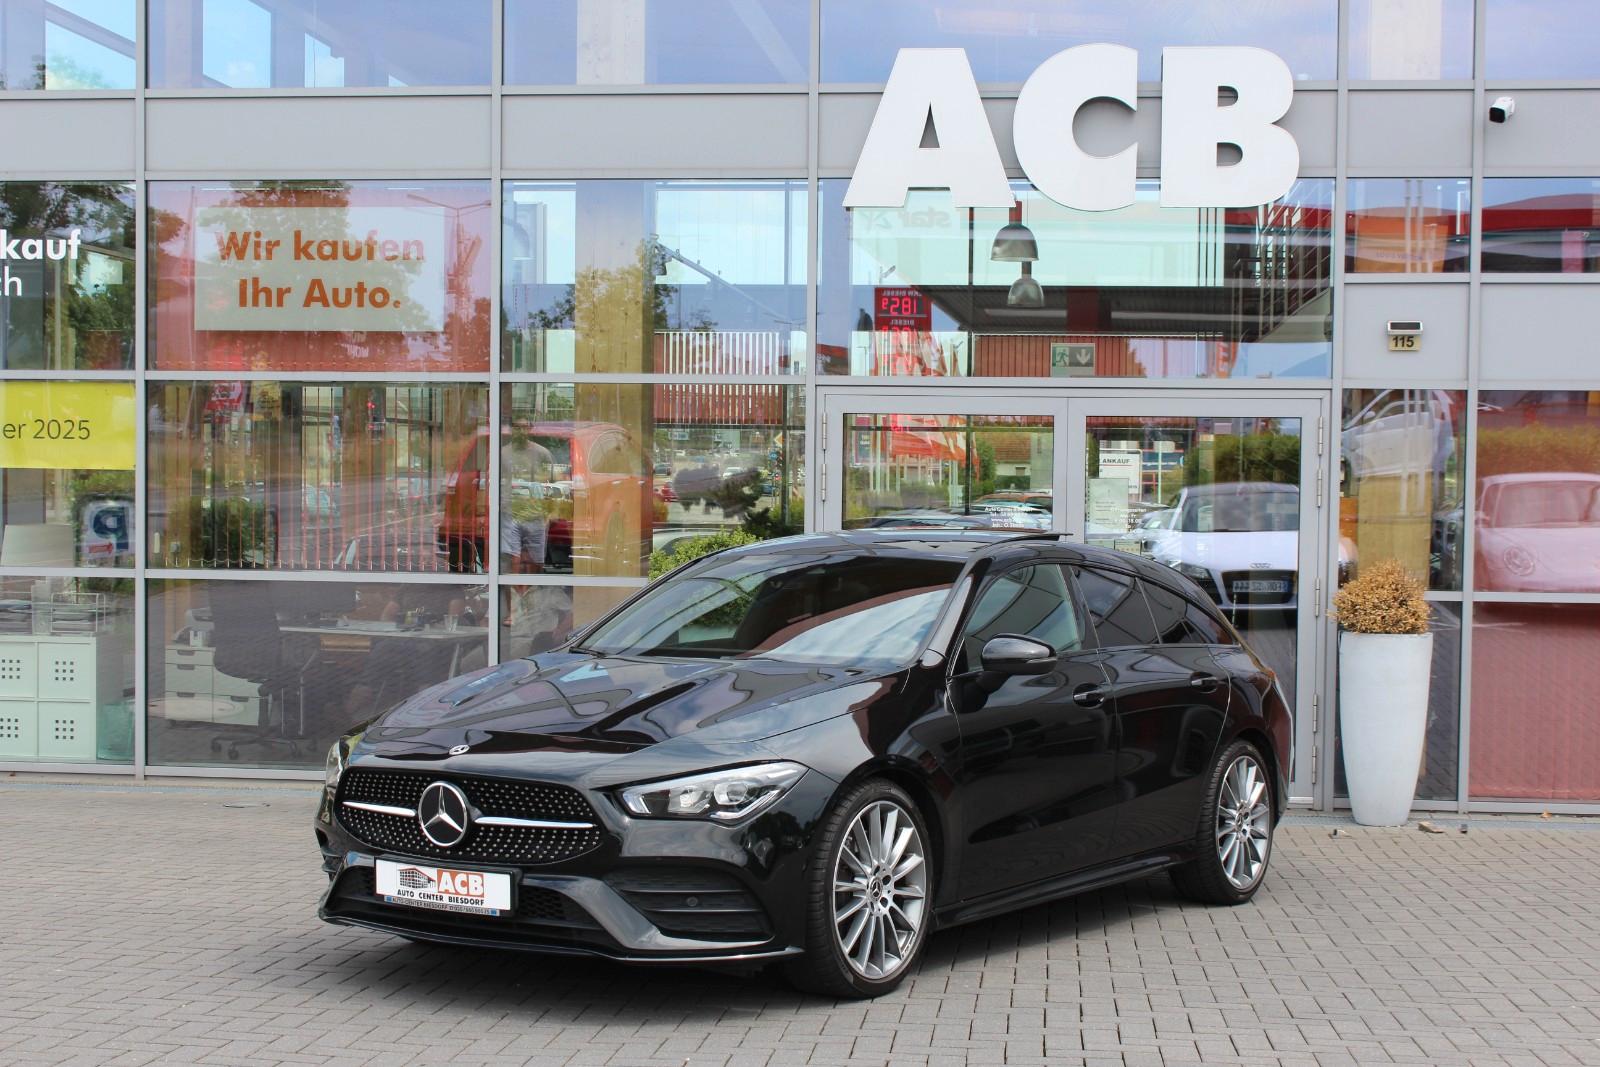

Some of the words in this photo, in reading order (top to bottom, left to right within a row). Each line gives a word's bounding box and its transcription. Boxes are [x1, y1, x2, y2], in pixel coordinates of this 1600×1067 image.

[842, 43, 1300, 212] ACB
[214, 230, 281, 261] Wir
[293, 229, 425, 262] kaufen
[238, 277, 292, 308] Ihr
[302, 278, 402, 309] Auto.
[1392, 336, 1415, 348] 115
[32, 419, 91, 441] 2025
[438, 871, 484, 896] ACB
[397, 888, 415, 898] AUTO
[418, 891, 444, 902] CENTER
[448, 895, 485, 906] BIESDORF
